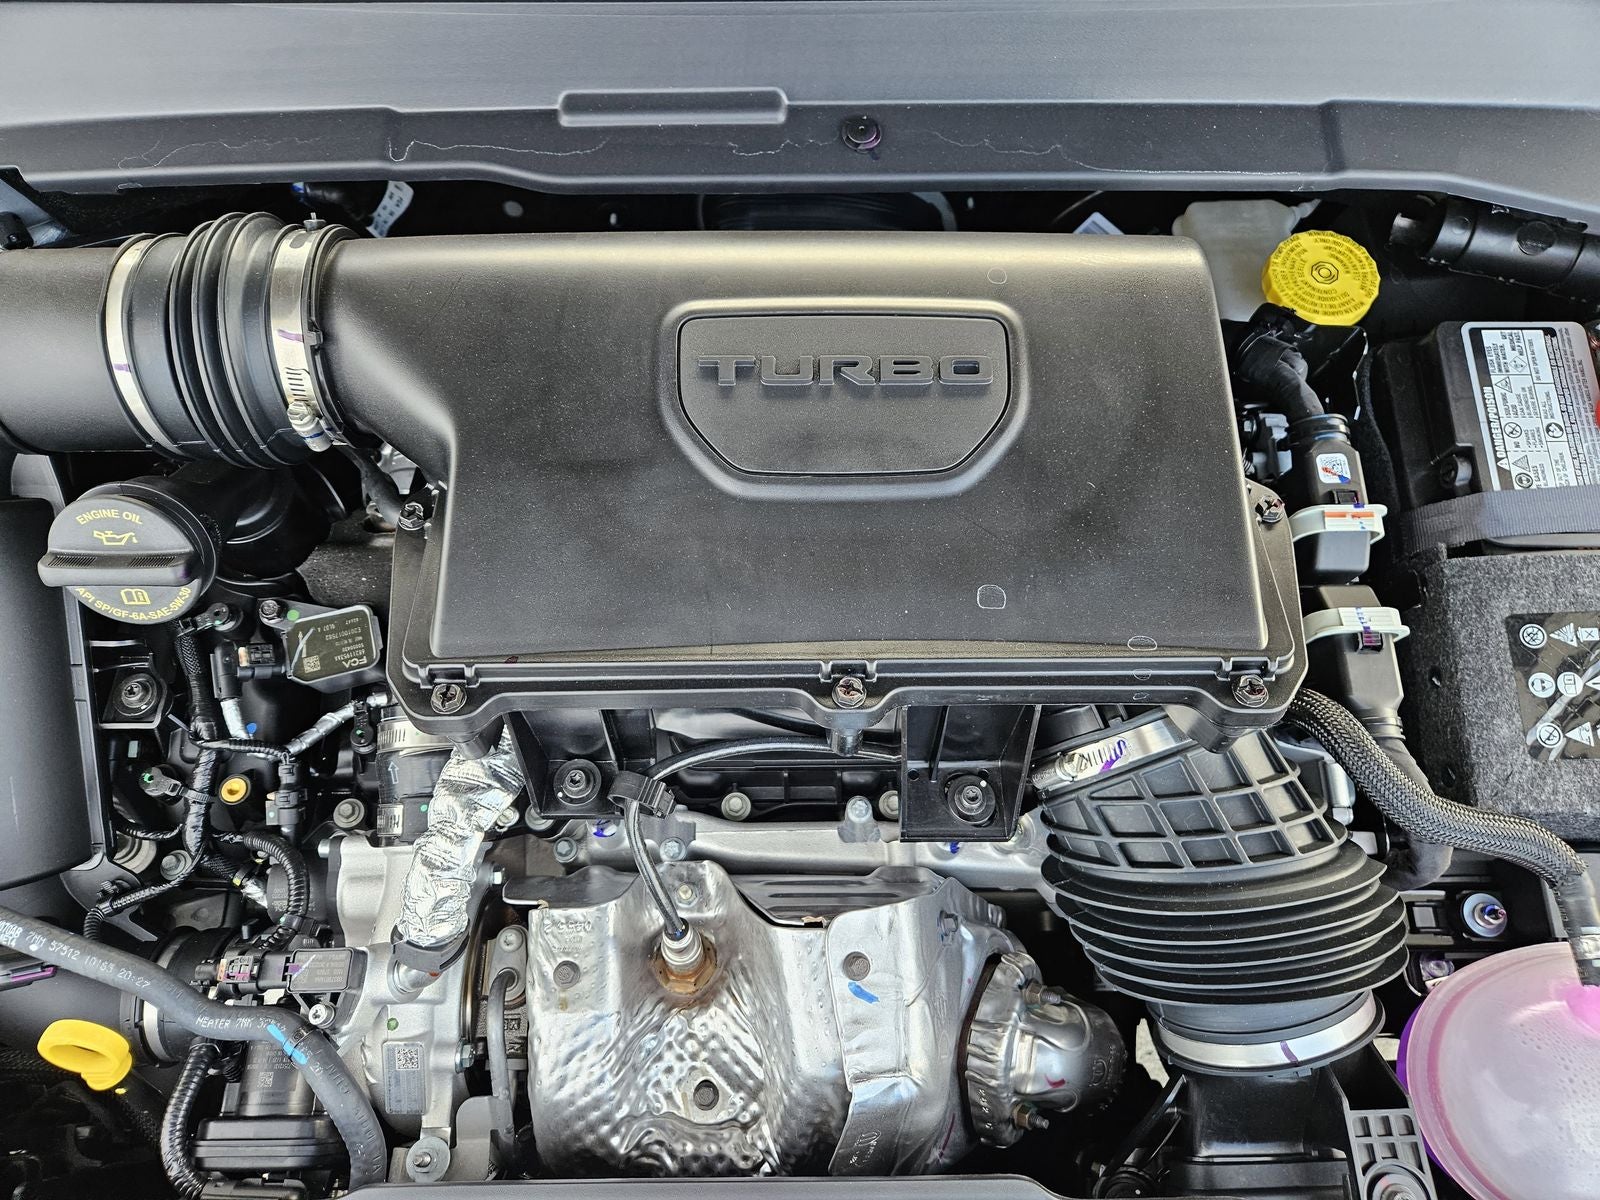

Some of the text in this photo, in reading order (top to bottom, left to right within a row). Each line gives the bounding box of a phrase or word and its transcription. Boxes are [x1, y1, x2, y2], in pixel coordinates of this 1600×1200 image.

[698, 355, 994, 386] TURBO
[1483, 387, 1506, 457] DANGER/POISON
[76, 509, 143, 525] ENGINE OIL
[75, 587, 96, 603] API
[342, 656, 367, 668] FCA
[196, 1015, 231, 1029] HEATER
